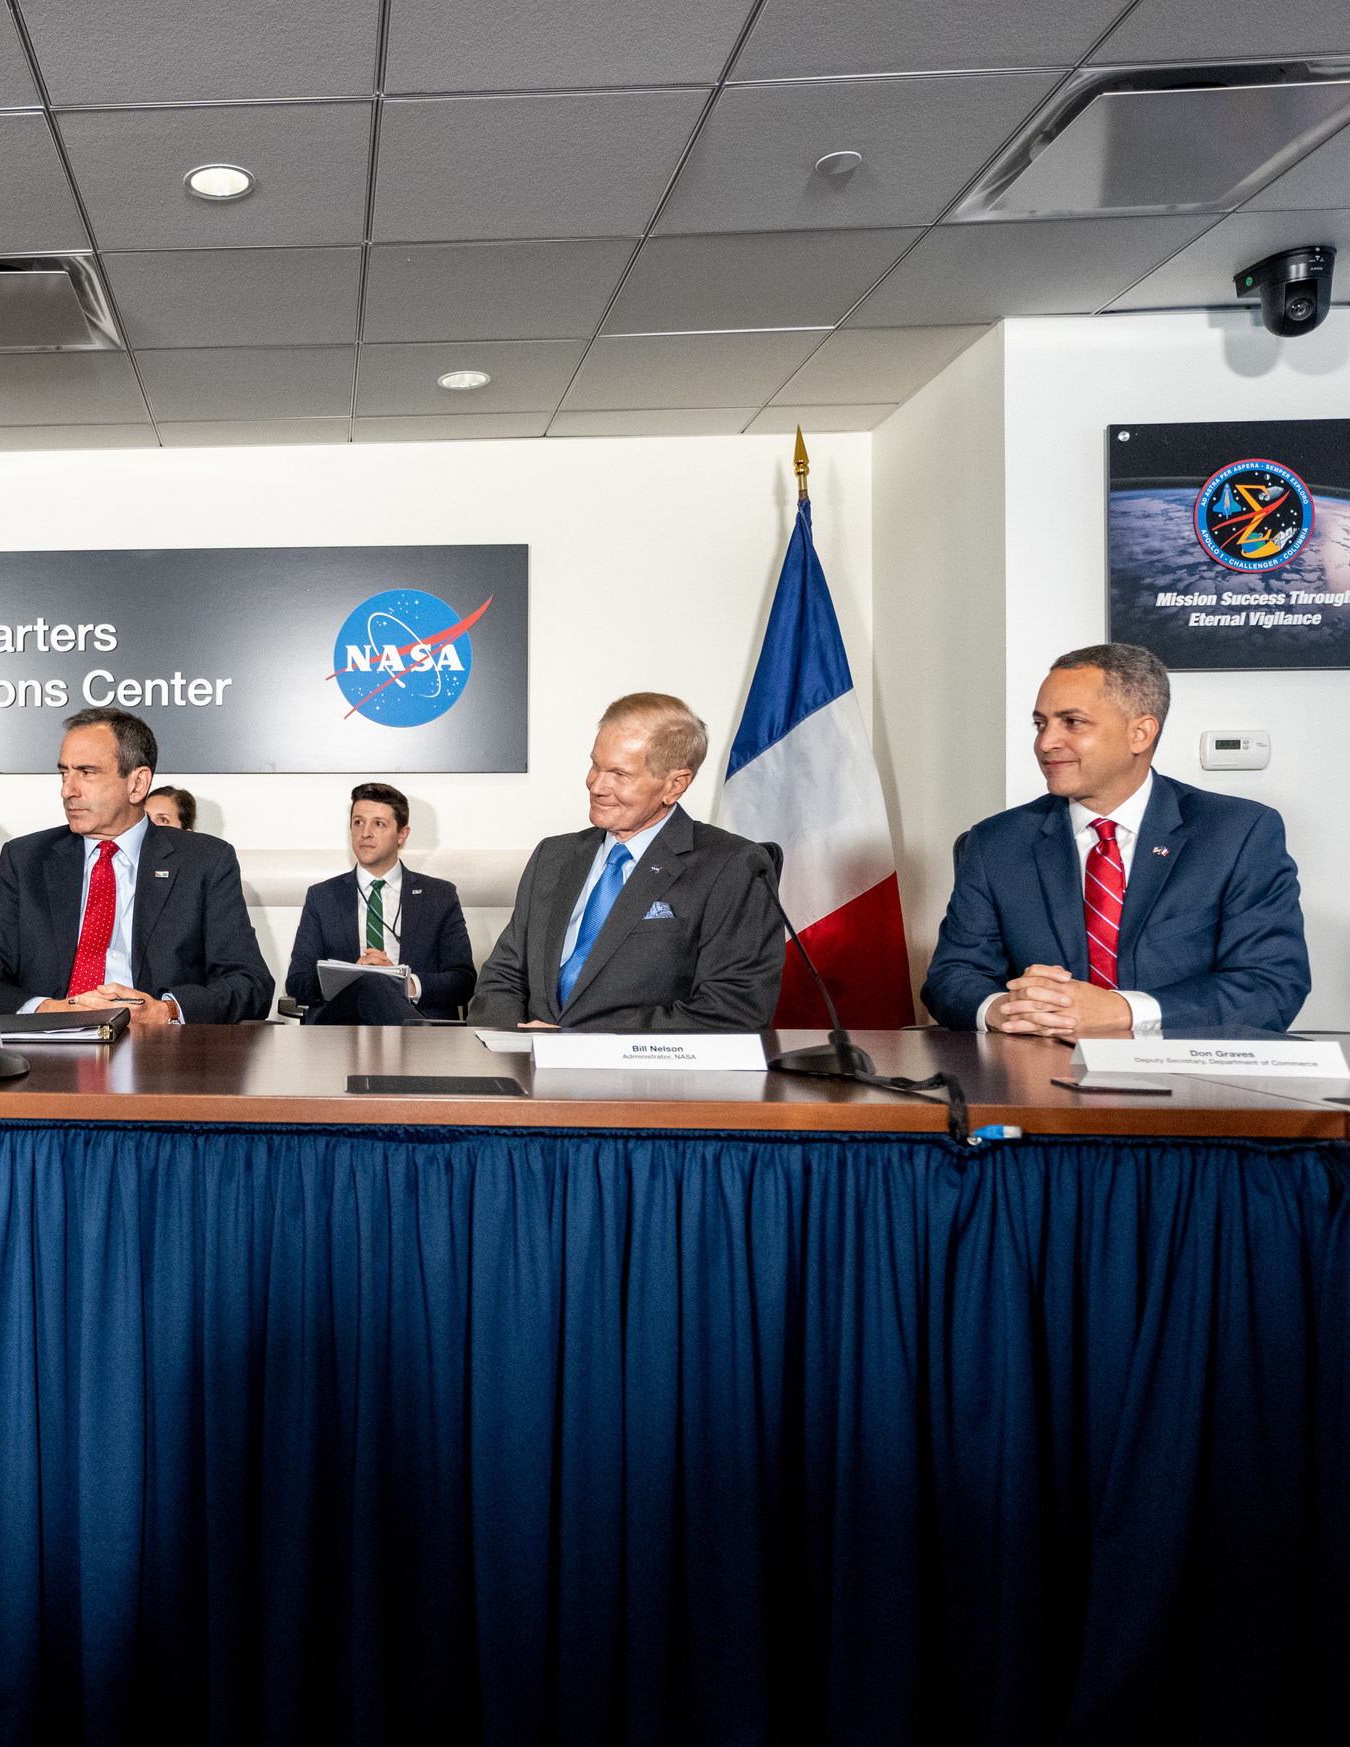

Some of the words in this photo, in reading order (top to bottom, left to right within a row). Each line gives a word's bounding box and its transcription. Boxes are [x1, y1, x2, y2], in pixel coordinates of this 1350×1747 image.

[1201, 498, 1207, 507] AD
[1205, 478, 1220, 497] ASTRA
[1219, 469, 1232, 480] PER
[1233, 463, 1259, 472] ASPERA
[1265, 464, 1290, 479] SEMPER
[1290, 475, 1309, 505] EXPLORO
[1201, 529, 1220, 555] APOLLO
[1229, 558, 1278, 569] CHALLENGER
[1283, 527, 1309, 559] COLUMBIA
[1155, 592, 1217, 607] Mission
[1221, 591, 1286, 606] Success
[1188, 612, 1247, 627] Eternal
[1249, 612, 1322, 628] Vigilance
[345, 644, 467, 674] NASA
[82, 669, 232, 708] Center
[632, 1045, 648, 1053] Bill
[650, 1045, 684, 1053] Nelson
[1215, 1050, 1255, 1058] Graves
